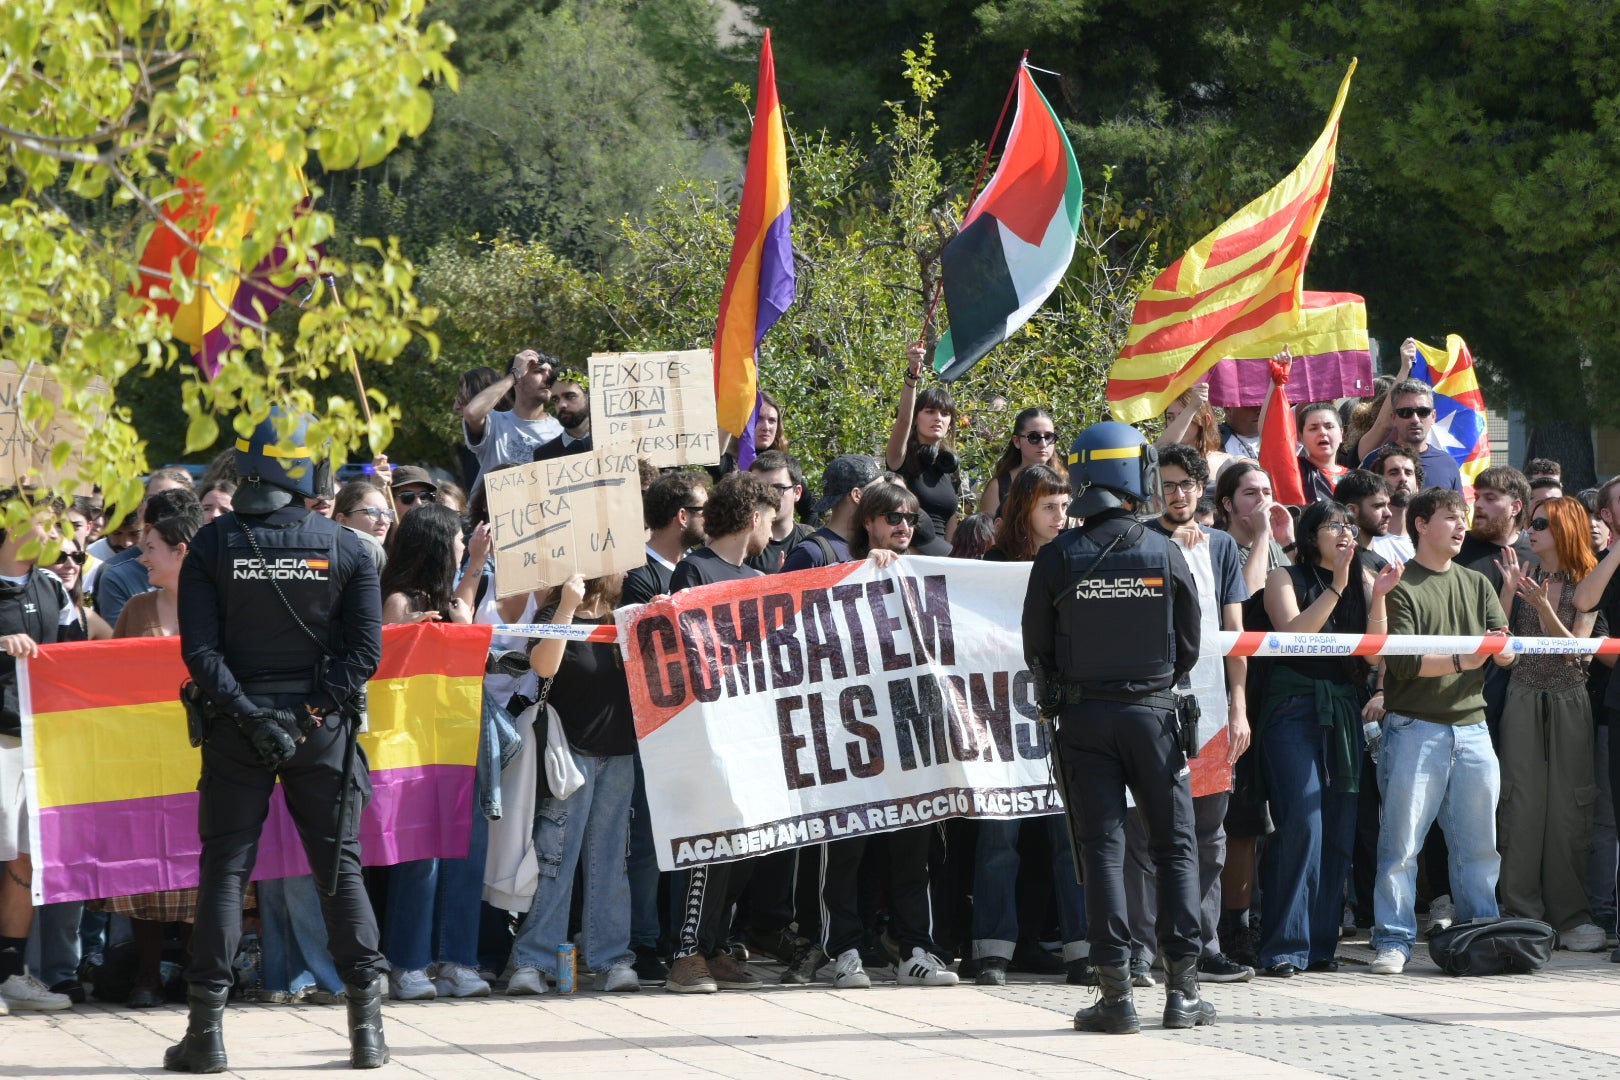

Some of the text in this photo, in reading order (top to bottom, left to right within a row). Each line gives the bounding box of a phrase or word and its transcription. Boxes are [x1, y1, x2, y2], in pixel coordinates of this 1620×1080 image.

[593, 361, 690, 388] FEIXISTES
[610, 417, 666, 434] DE LA
[601, 433, 714, 453] VERSITAT
[546, 454, 637, 487] FASCISTAS
[494, 496, 571, 541] FUERA
[523, 528, 616, 567] DE LA UA
[233, 558, 309, 569] POLICIA
[233, 569, 329, 580] NACIONAL
[1076, 577, 1146, 589] POLICIA
[1076, 588, 1163, 600] NACIONAL
[637, 574, 956, 708] COMBATEM
[1280, 645, 1304, 654] LINEA
[1307, 645, 1318, 654] DE
[1320, 645, 1351, 654] POLICIA
[1294, 635, 1337, 644] NO PASAR
[775, 669, 1051, 791] ELS MONS
[676, 827, 776, 864] ACABEM
[776, 817, 827, 846] AMB
[829, 812, 866, 836] LA
[867, 789, 969, 829] REACCIÓ
